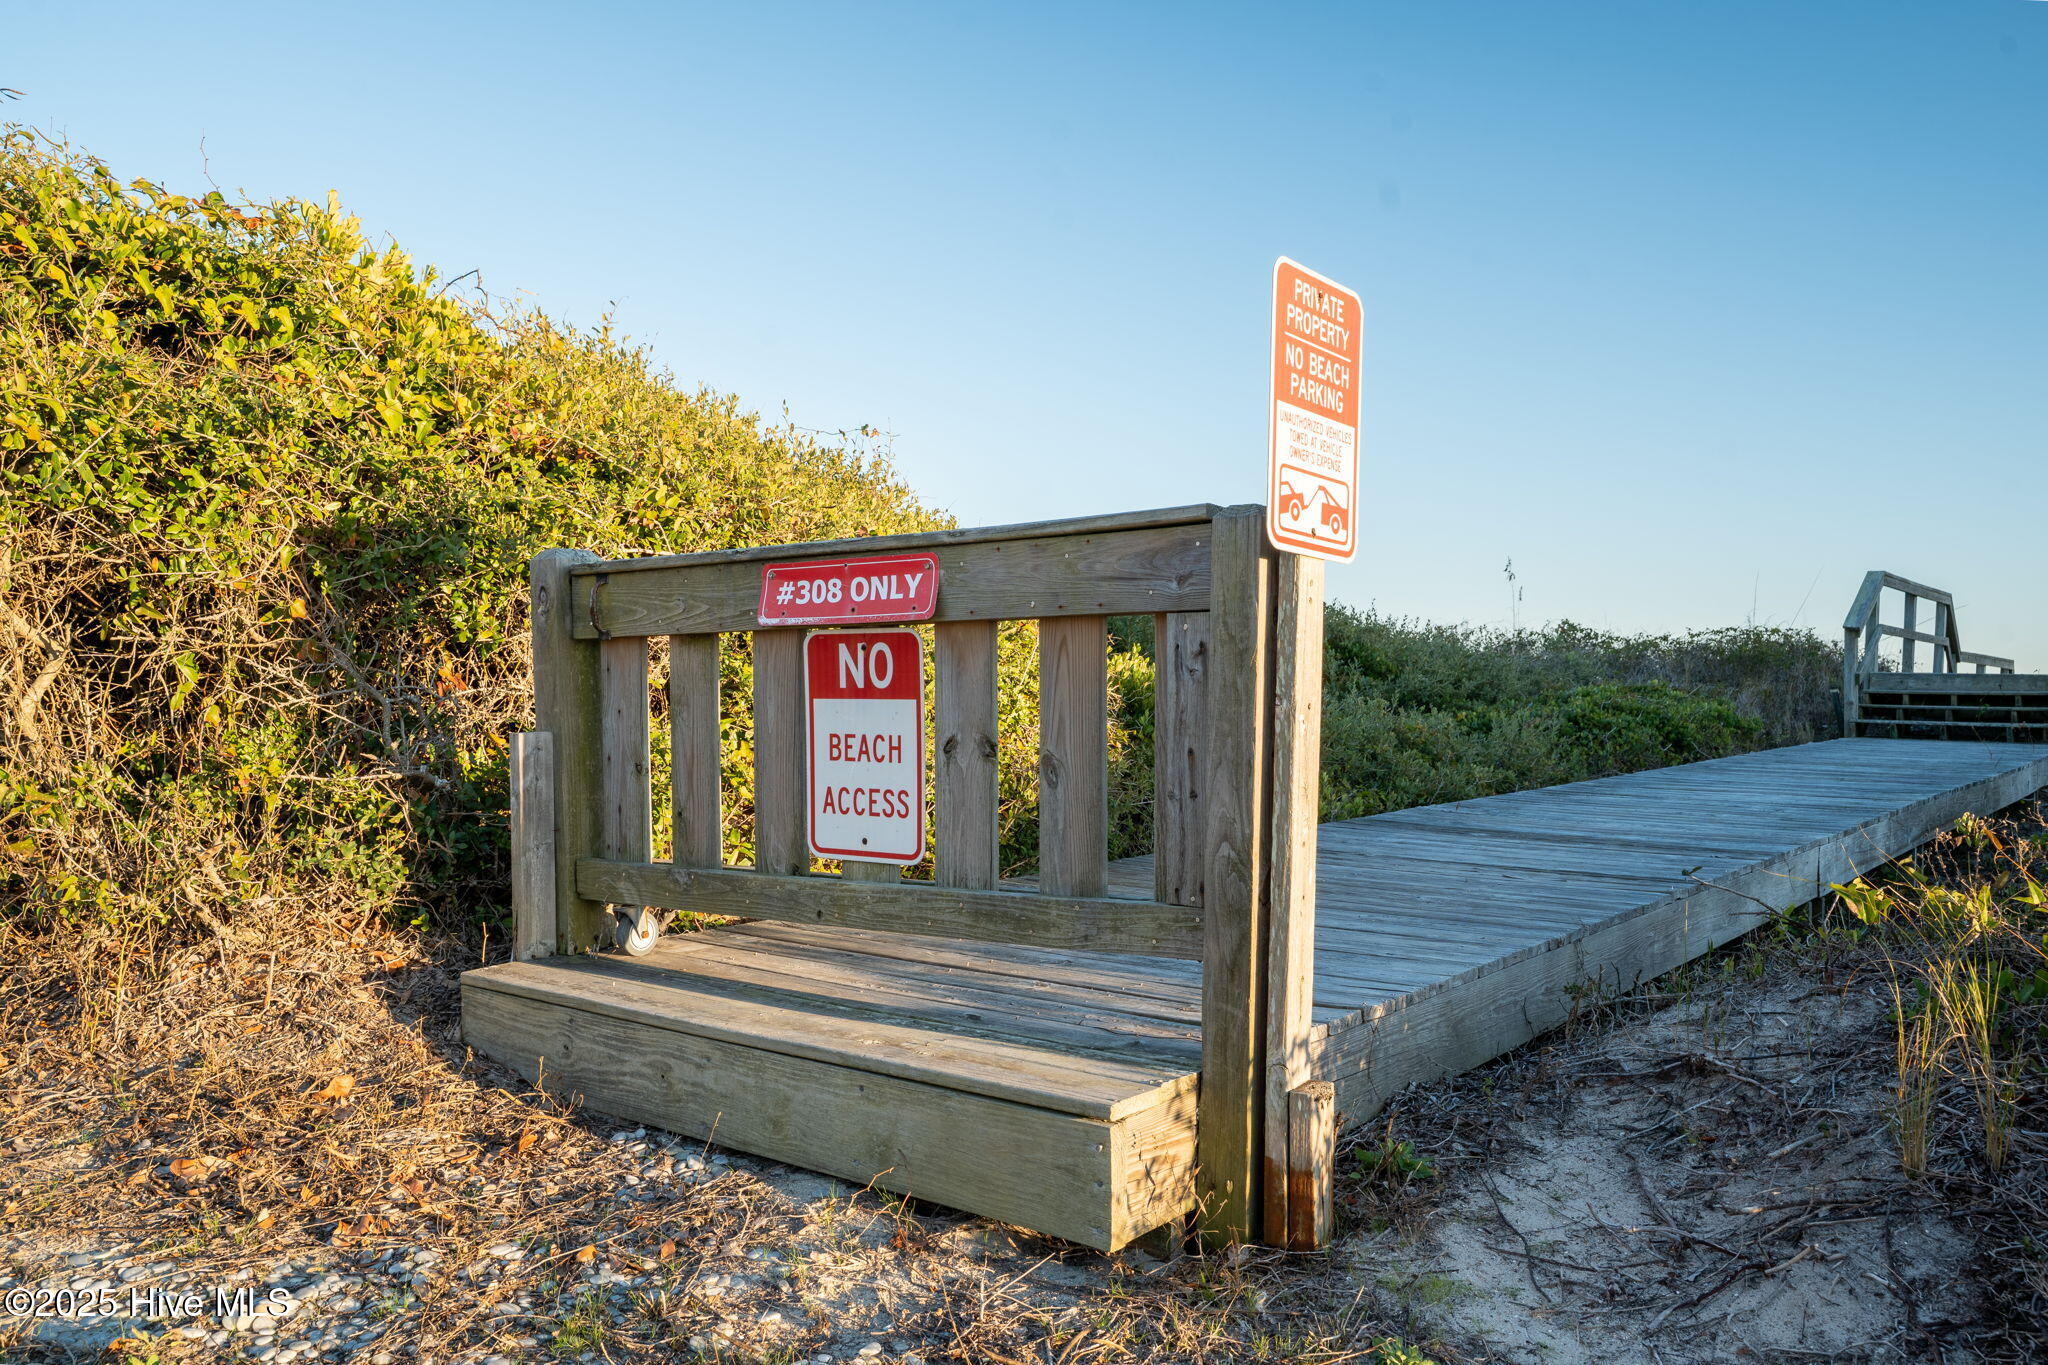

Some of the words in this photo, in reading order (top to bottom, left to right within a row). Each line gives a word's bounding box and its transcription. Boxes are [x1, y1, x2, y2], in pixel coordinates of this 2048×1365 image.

[1294, 278, 1345, 323] PRIVATE
[1286, 303, 1350, 351] PROPERTY
[1285, 342, 1304, 370] NO
[1309, 352, 1350, 390] BEACH
[1290, 372, 1344, 414] PARKING
[1280, 409, 1324, 436] UNAUTHORIZED
[1326, 425, 1352, 446] VEHICLES
[1289, 428, 1309, 446] TOWED
[1311, 436, 1318, 449] AT
[1319, 439, 1343, 458] VEHICLE
[1316, 453, 1342, 473] EXPENSE
[776, 577, 843, 605] #308
[850, 573, 924, 602] ONLY
[838, 641, 894, 689] NO
[829, 733, 902, 764] BEACH
[822, 786, 910, 819] ACCESS
